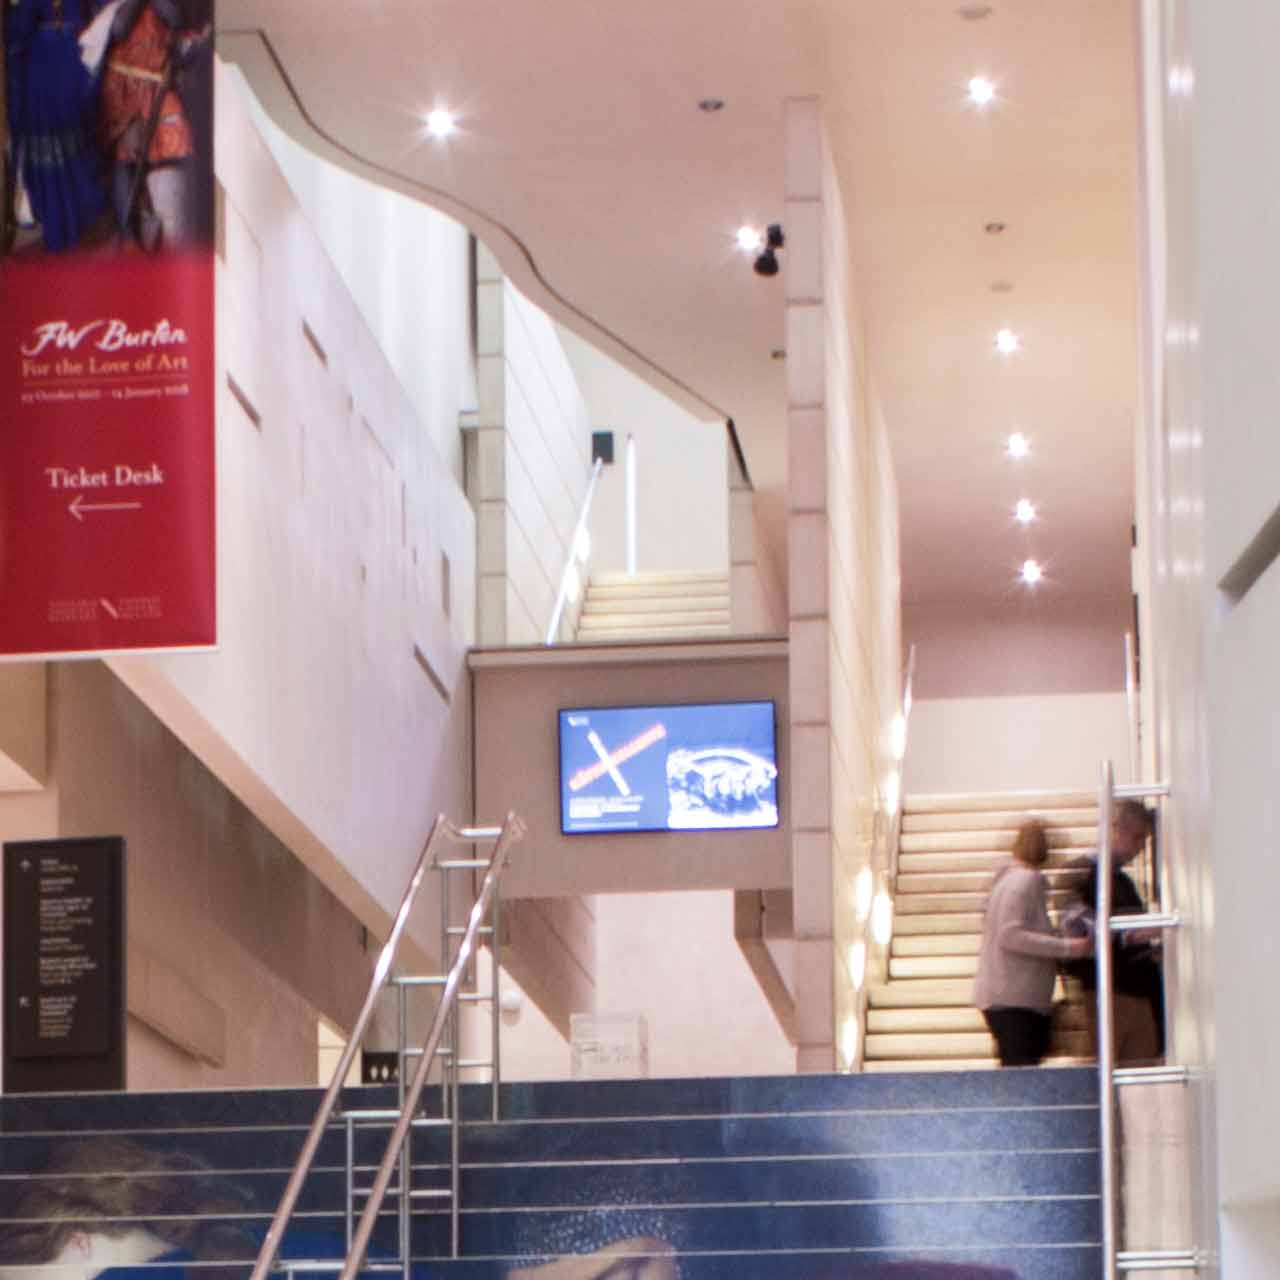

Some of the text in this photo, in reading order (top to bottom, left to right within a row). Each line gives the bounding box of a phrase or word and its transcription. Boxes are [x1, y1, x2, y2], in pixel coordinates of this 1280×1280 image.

[96, 318, 187, 351] Burton
[23, 354, 188, 376] For the Love of Art
[44, 463, 164, 488] Ticket Desk
